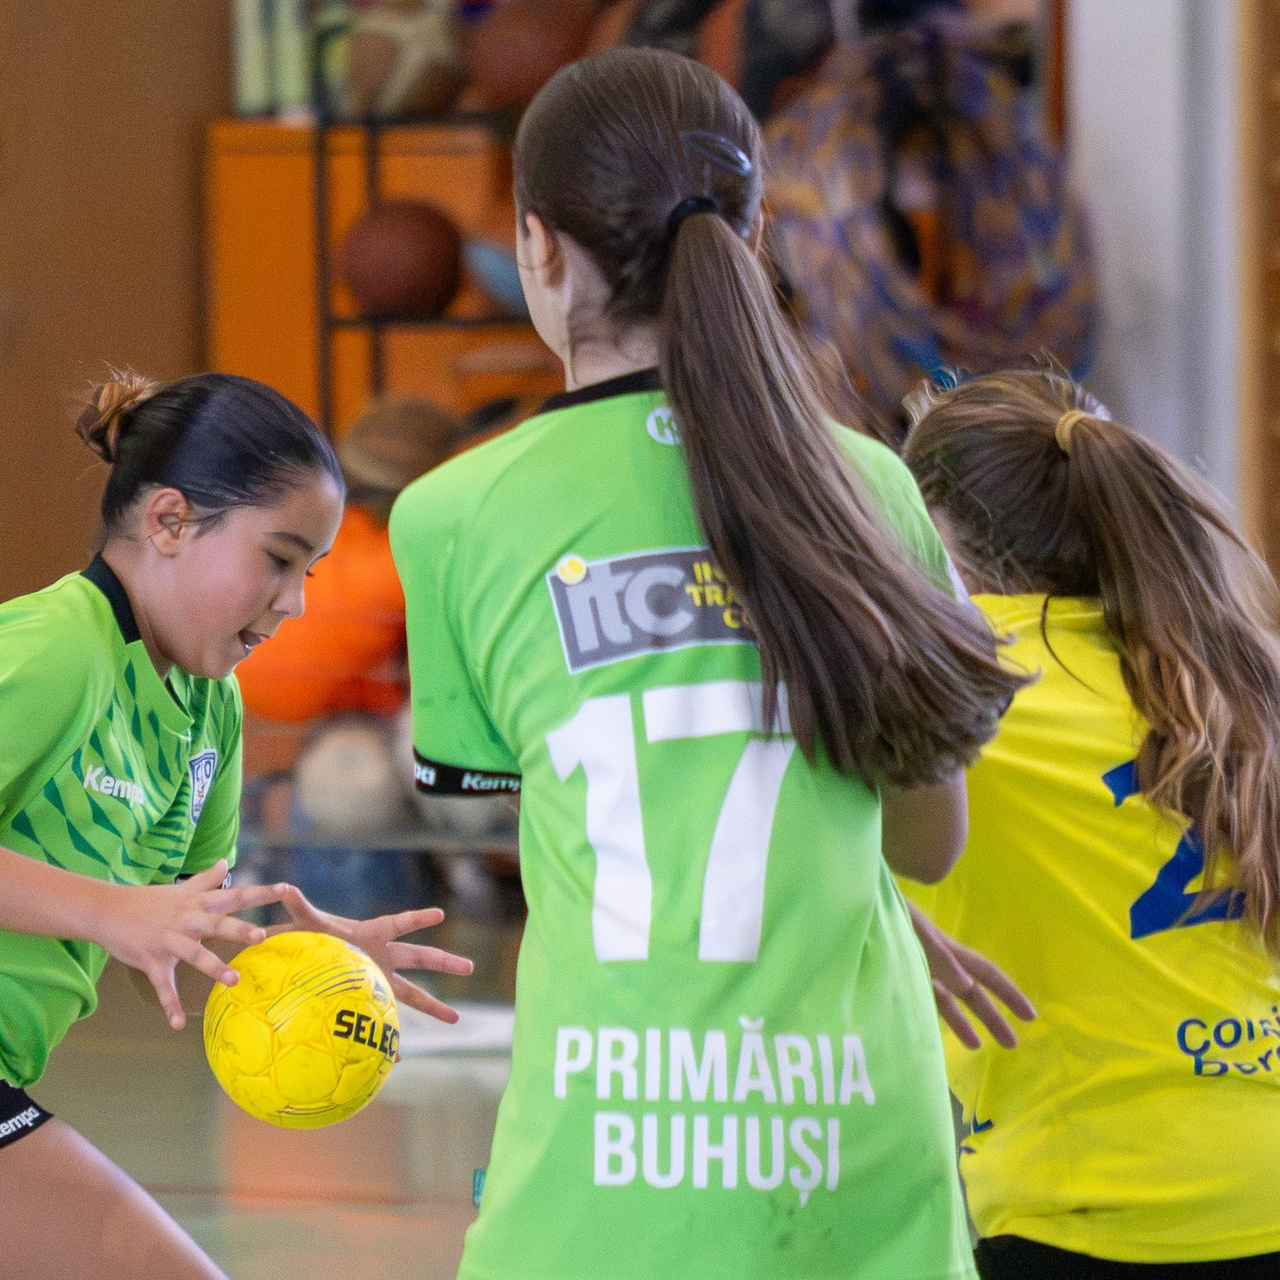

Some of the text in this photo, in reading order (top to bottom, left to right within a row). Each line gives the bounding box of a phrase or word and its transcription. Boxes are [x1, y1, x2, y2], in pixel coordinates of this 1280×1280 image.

[546, 680, 796, 962] 17
[333, 1008, 400, 1057] SELEC
[554, 1016, 876, 1106] PRIMĂRIA
[593, 1111, 840, 1208] BUHUȘI
